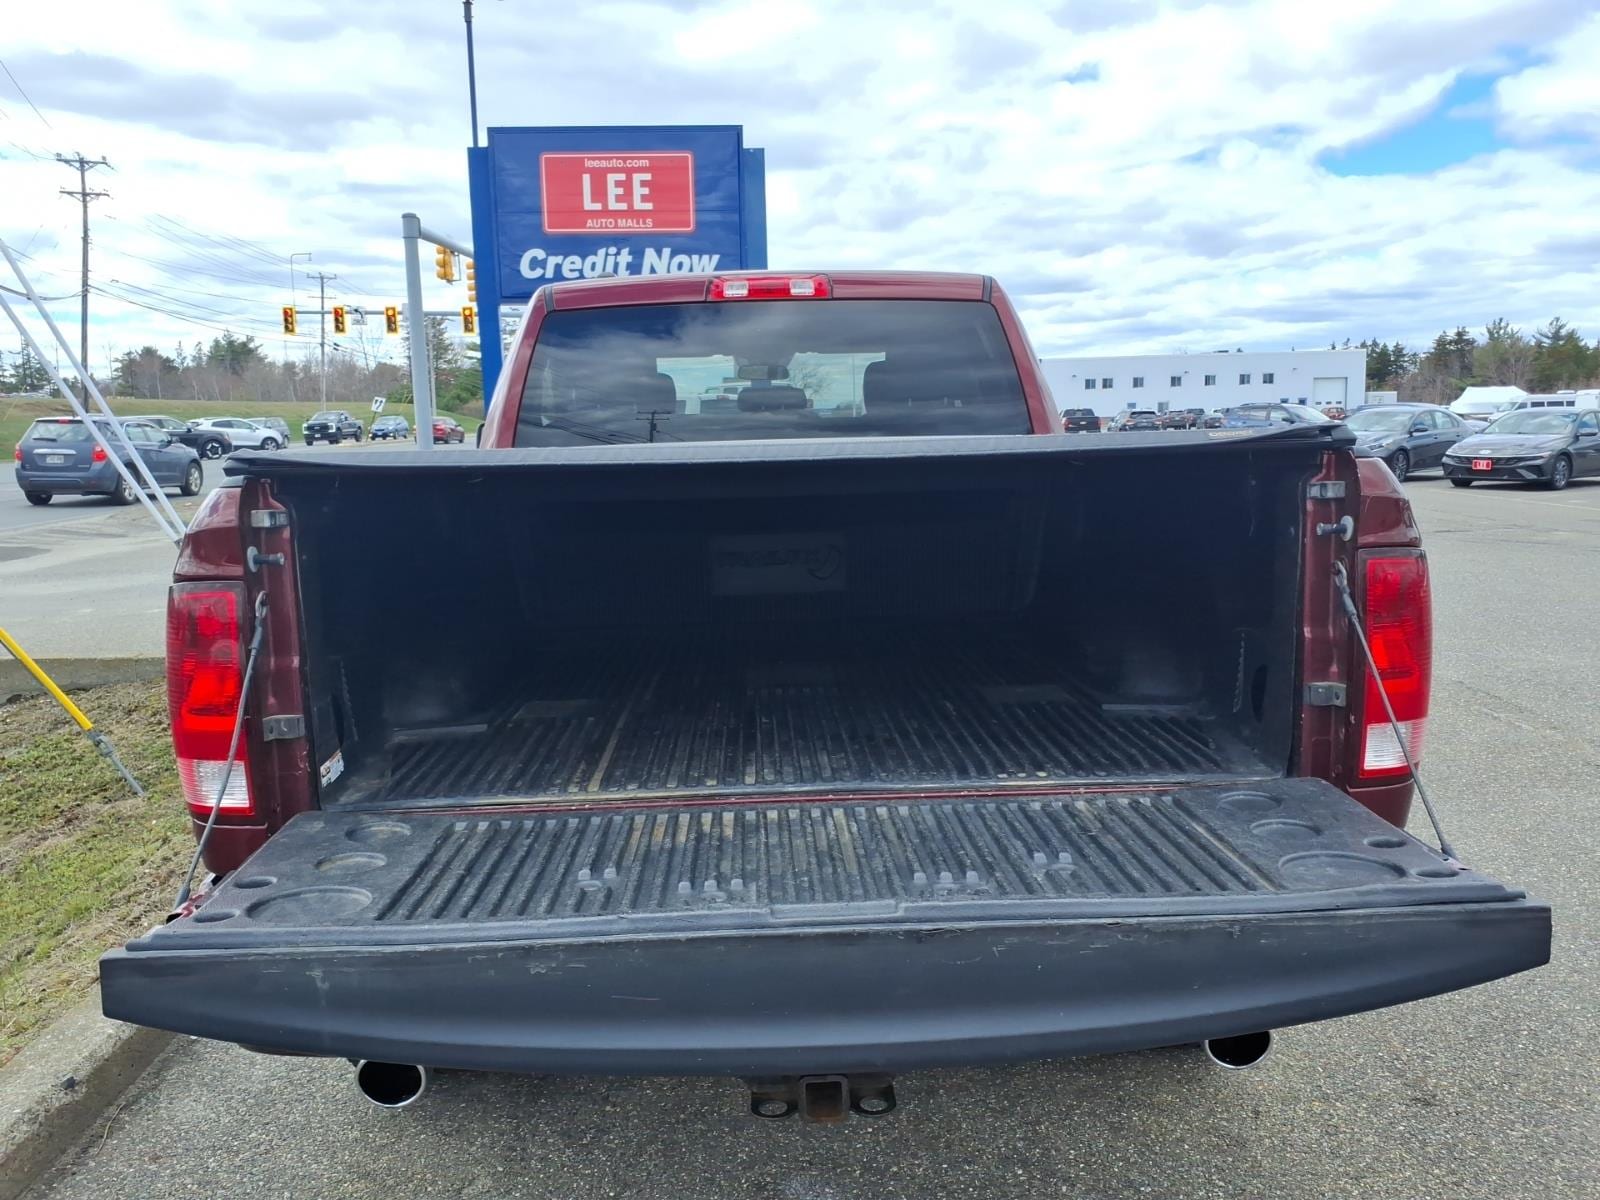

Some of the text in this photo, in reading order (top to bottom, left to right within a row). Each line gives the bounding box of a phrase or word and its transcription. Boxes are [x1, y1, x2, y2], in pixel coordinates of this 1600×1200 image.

[584, 158, 650, 168] leeauto.com
[581, 172, 654, 211] LEE
[585, 218, 653, 228] AUTO MALLS
[519, 246, 721, 280] Credit Now
